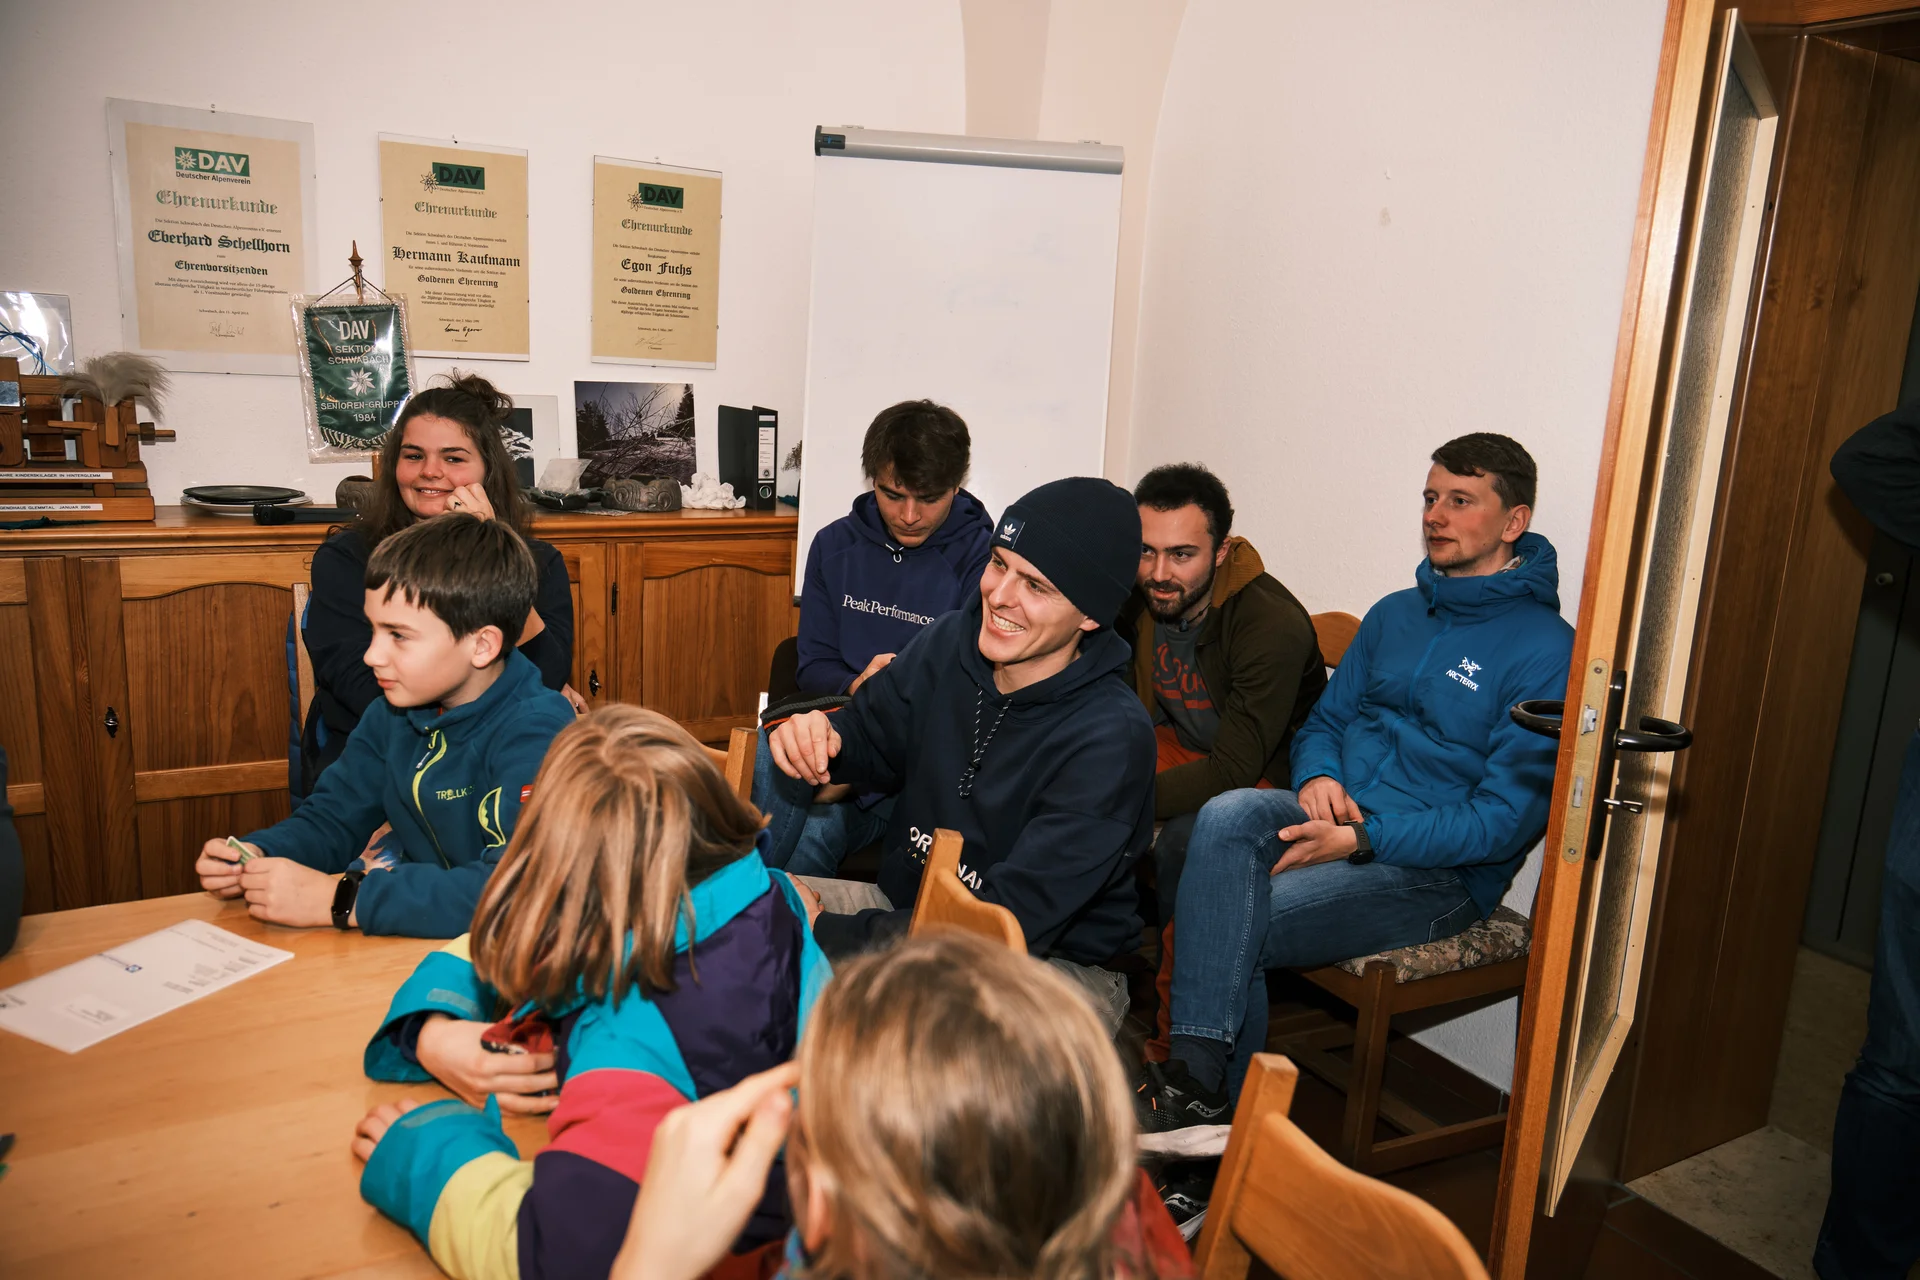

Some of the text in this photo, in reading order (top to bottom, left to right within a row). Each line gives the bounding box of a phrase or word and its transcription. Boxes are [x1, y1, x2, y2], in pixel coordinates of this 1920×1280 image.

[198, 152, 247, 174] DAV
[175, 171, 251, 185] Deutscher Alpenverein
[439, 166, 482, 185] DAV
[156, 189, 278, 215] Ehrenurkunde
[643, 186, 682, 205] DAV
[414, 201, 498, 219] Ehrenurkunde
[621, 219, 693, 235] Ehrenurkunde
[148, 229, 291, 253] Eberhard Schellhorn
[392, 246, 521, 267] Hermann Kaufmann
[174, 260, 269, 276] Ehrenvorsitzenden
[621, 258, 693, 277] Egon Fuchs
[417, 274, 499, 288] Goldenen Ehrenring
[620, 286, 691, 300] Goldenen Ehrenring
[340, 320, 369, 340] DAV
[328, 355, 390, 365] SCHWABACH
[320, 401, 402, 410] SENIOREN-GRUPP
[353, 413, 377, 422] 1984
